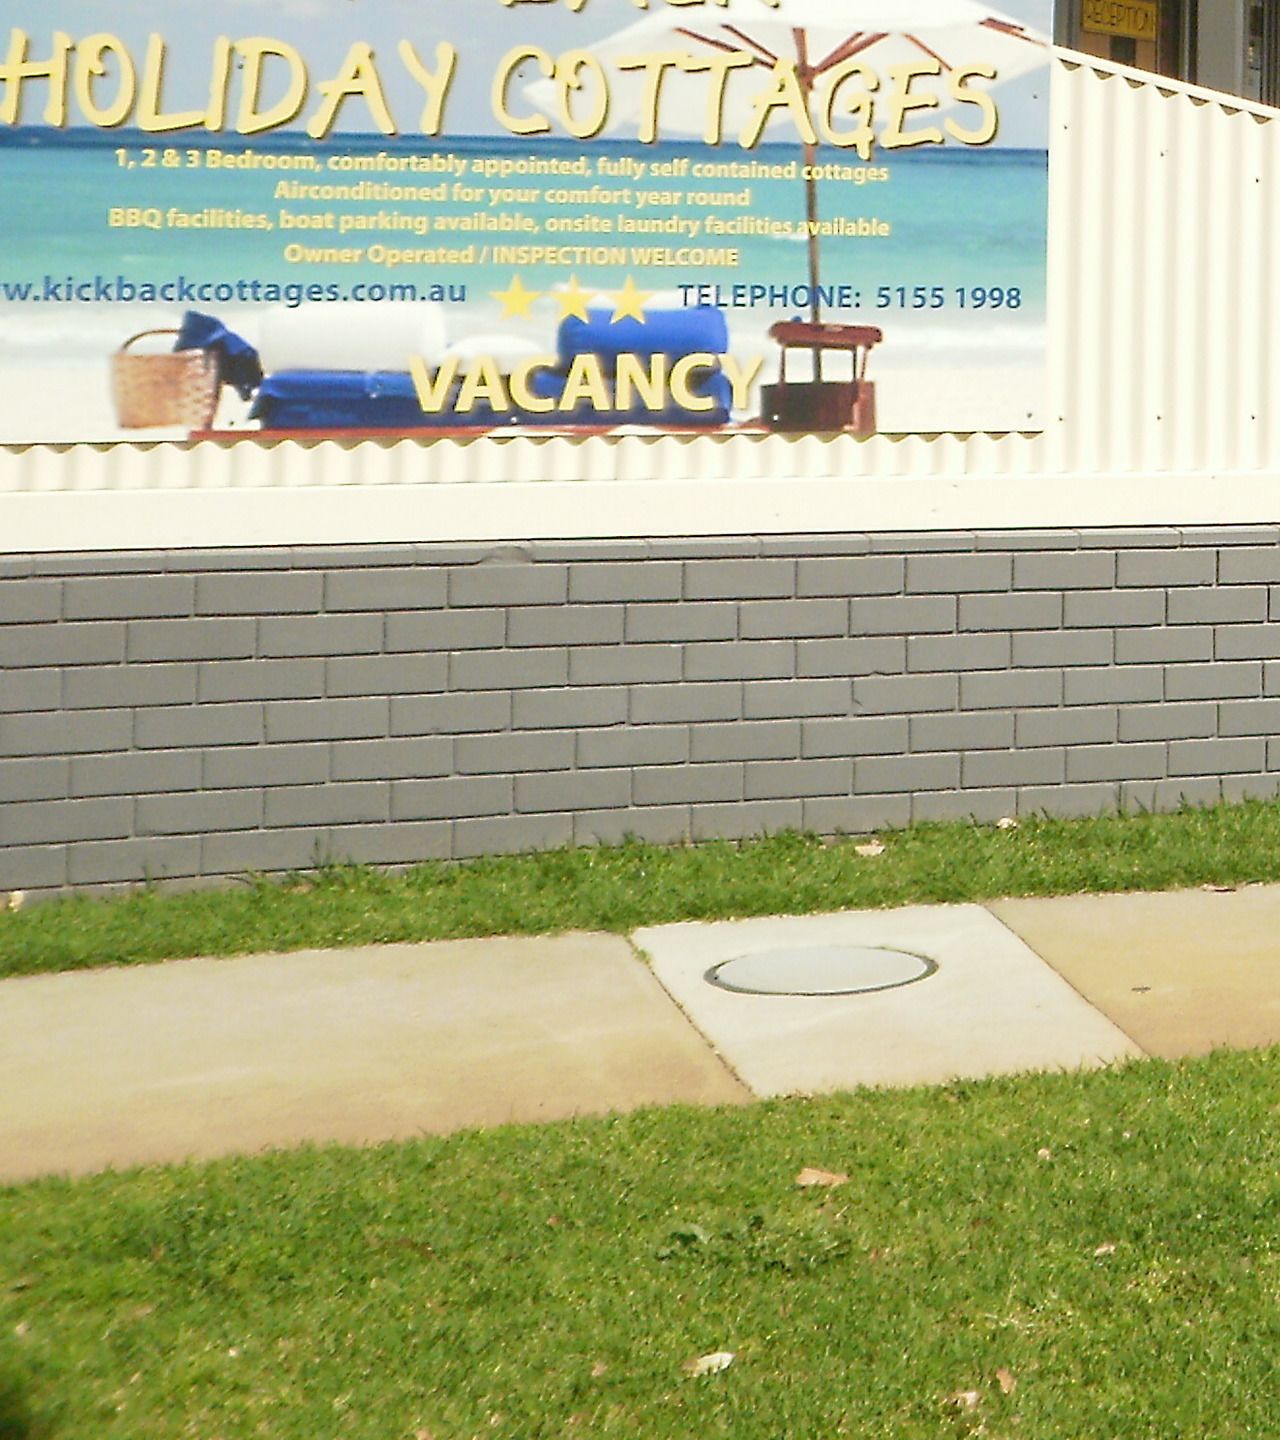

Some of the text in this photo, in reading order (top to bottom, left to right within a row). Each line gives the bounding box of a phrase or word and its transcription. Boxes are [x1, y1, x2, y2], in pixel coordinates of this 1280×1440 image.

[0, 27, 999, 160] HOLIDAY COTTAGES
[114, 148, 889, 185] 1, 2 & 3 Bedroom, comfortably appointed, fully self contained cottages
[273, 180, 752, 208] Airconditioned for your comfort year round
[107, 208, 892, 237] BBQ facilities, boat parking available, onsite laundry facilities available
[283, 244, 363, 264] Owner
[367, 245, 475, 267] Operated
[492, 246, 627, 266] INSPECTION
[630, 248, 740, 267] WELCOME
[677, 284, 1022, 309] TELEPHONE: 5155 1998
[407, 352, 765, 414] VACANCY
